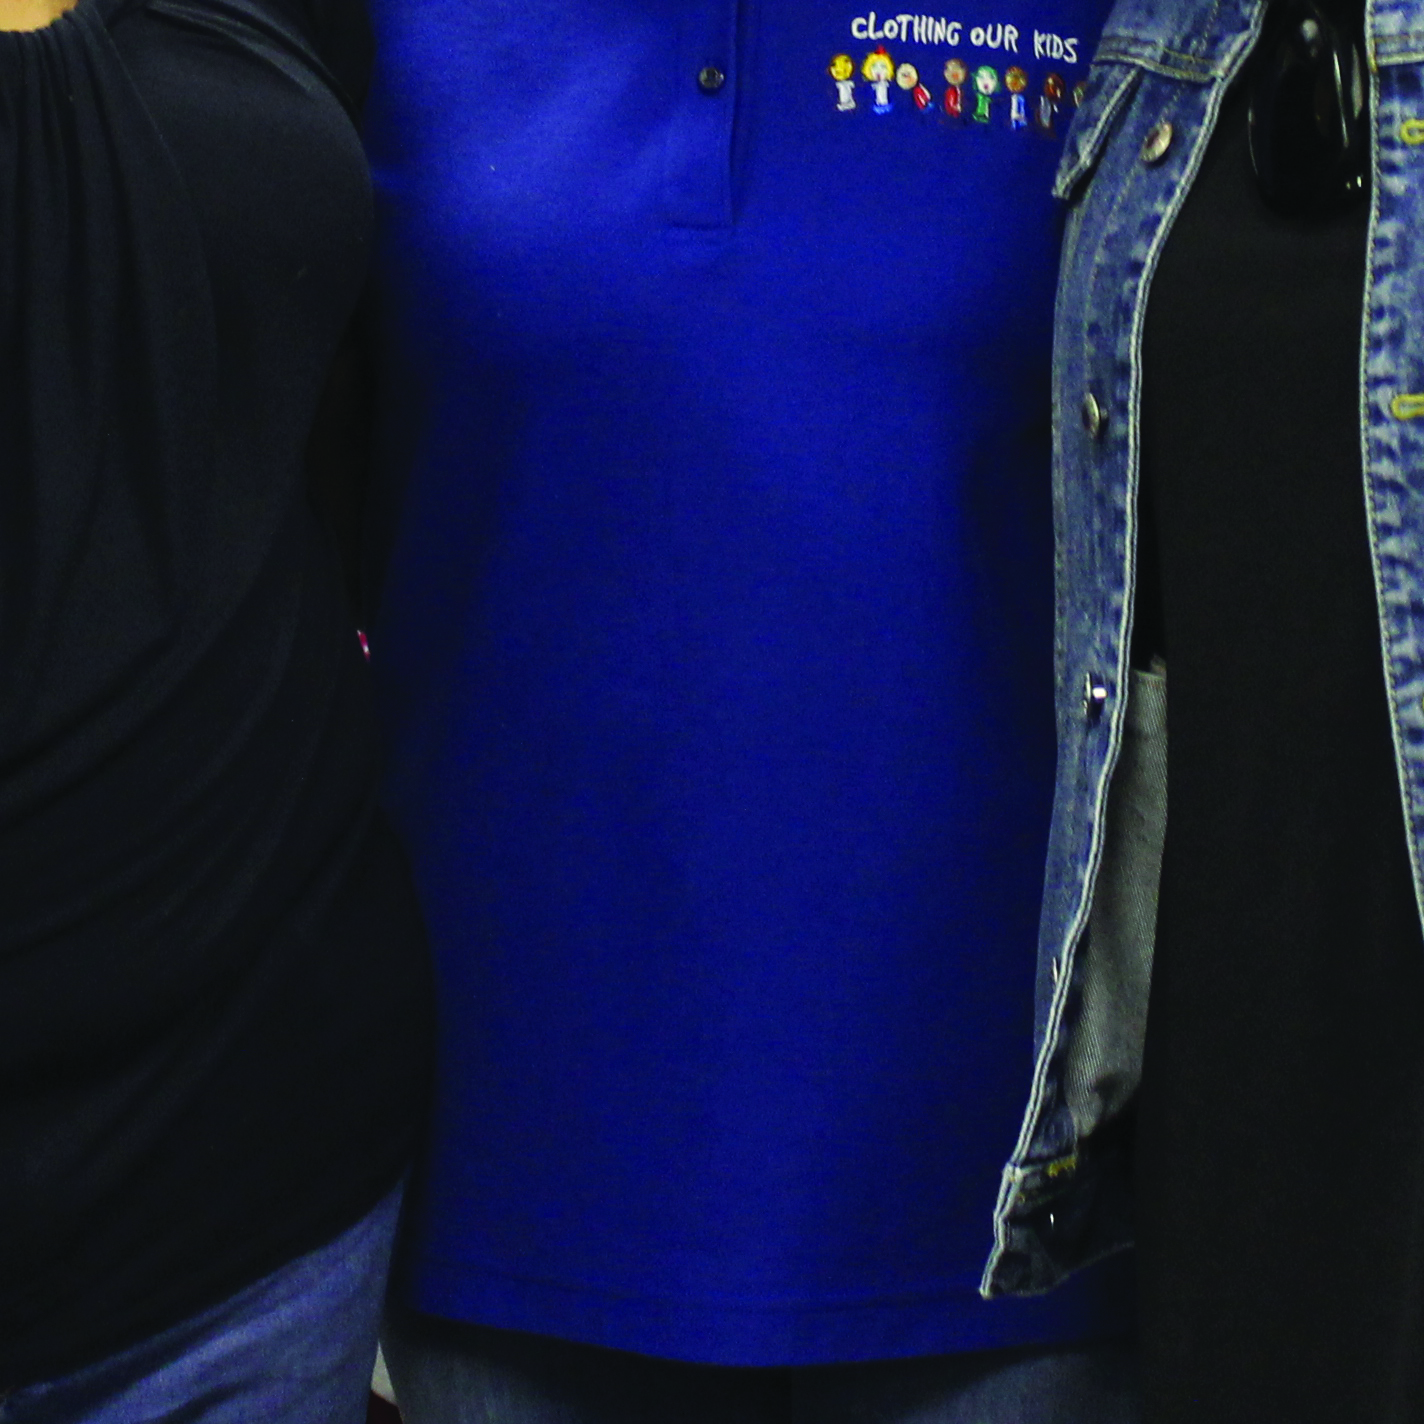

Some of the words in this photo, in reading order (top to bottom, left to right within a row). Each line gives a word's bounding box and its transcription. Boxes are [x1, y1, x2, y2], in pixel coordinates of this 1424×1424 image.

[851, 11, 963, 47] CLOTHING
[970, 23, 1019, 54] OUR
[1033, 29, 1079, 65] KIDS
